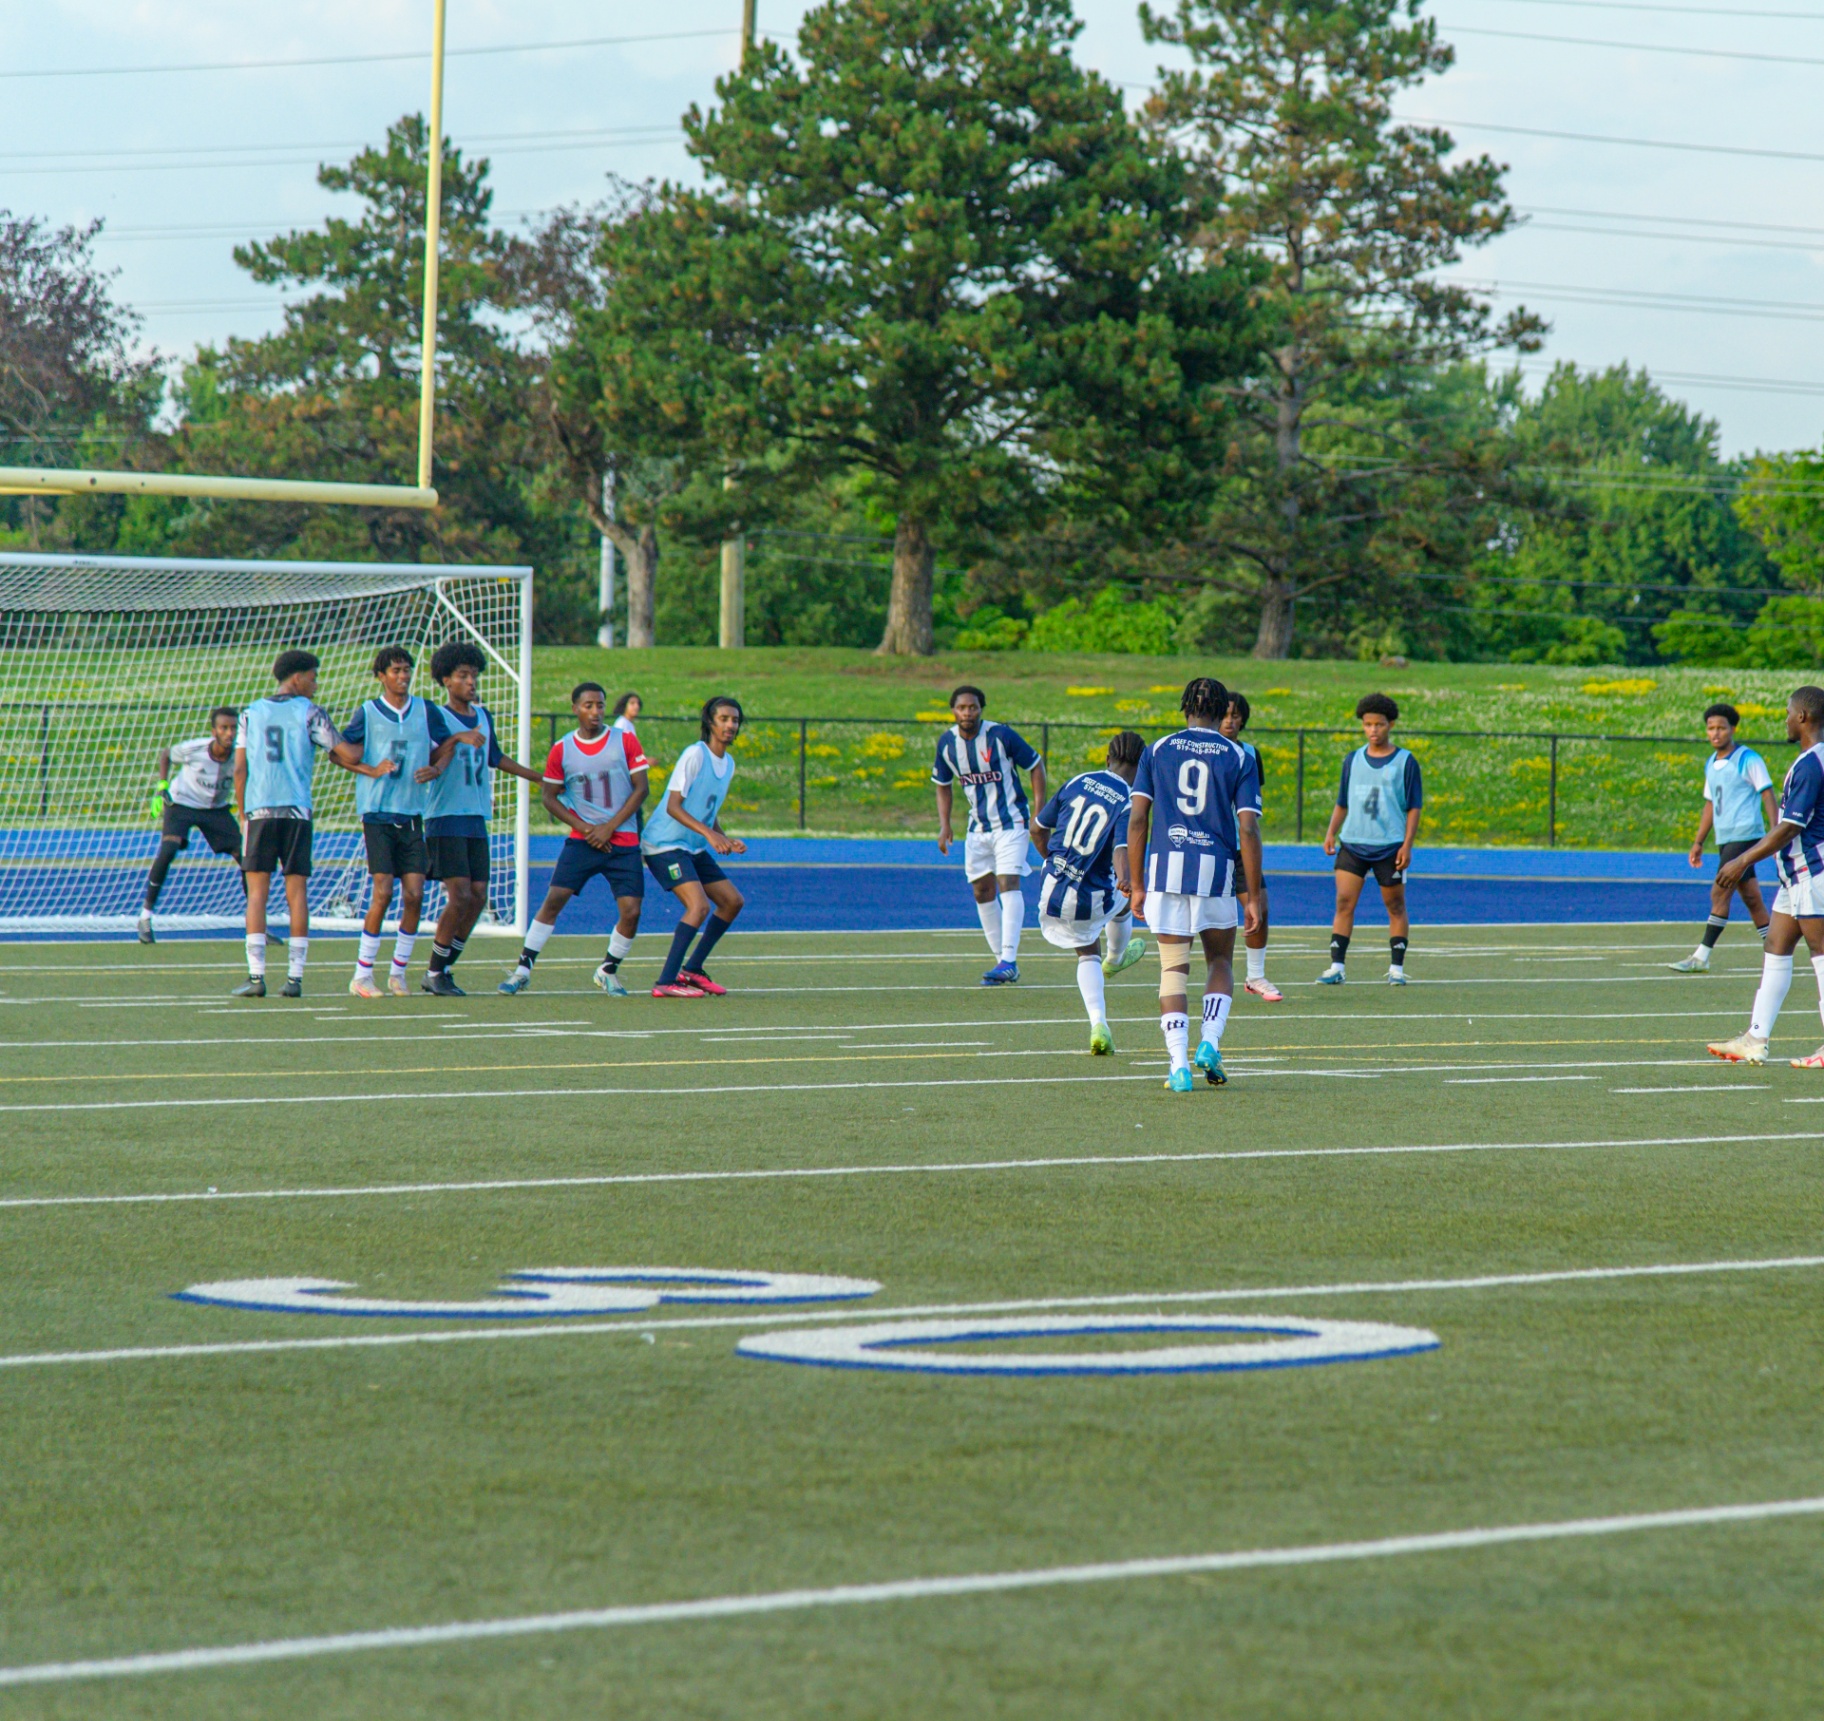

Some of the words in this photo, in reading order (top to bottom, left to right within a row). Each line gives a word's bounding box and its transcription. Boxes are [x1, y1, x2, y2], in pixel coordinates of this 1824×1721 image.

[265, 725, 285, 763] 9
[1187, 740, 1229, 752] CONSTRUCTION
[459, 748, 485, 786] 12
[577, 771, 612, 809] 11
[1176, 758, 1209, 816] 9
[1364, 787, 1380, 820] 4
[1715, 785, 1723, 817] 3
[1062, 794, 1109, 856] 10
